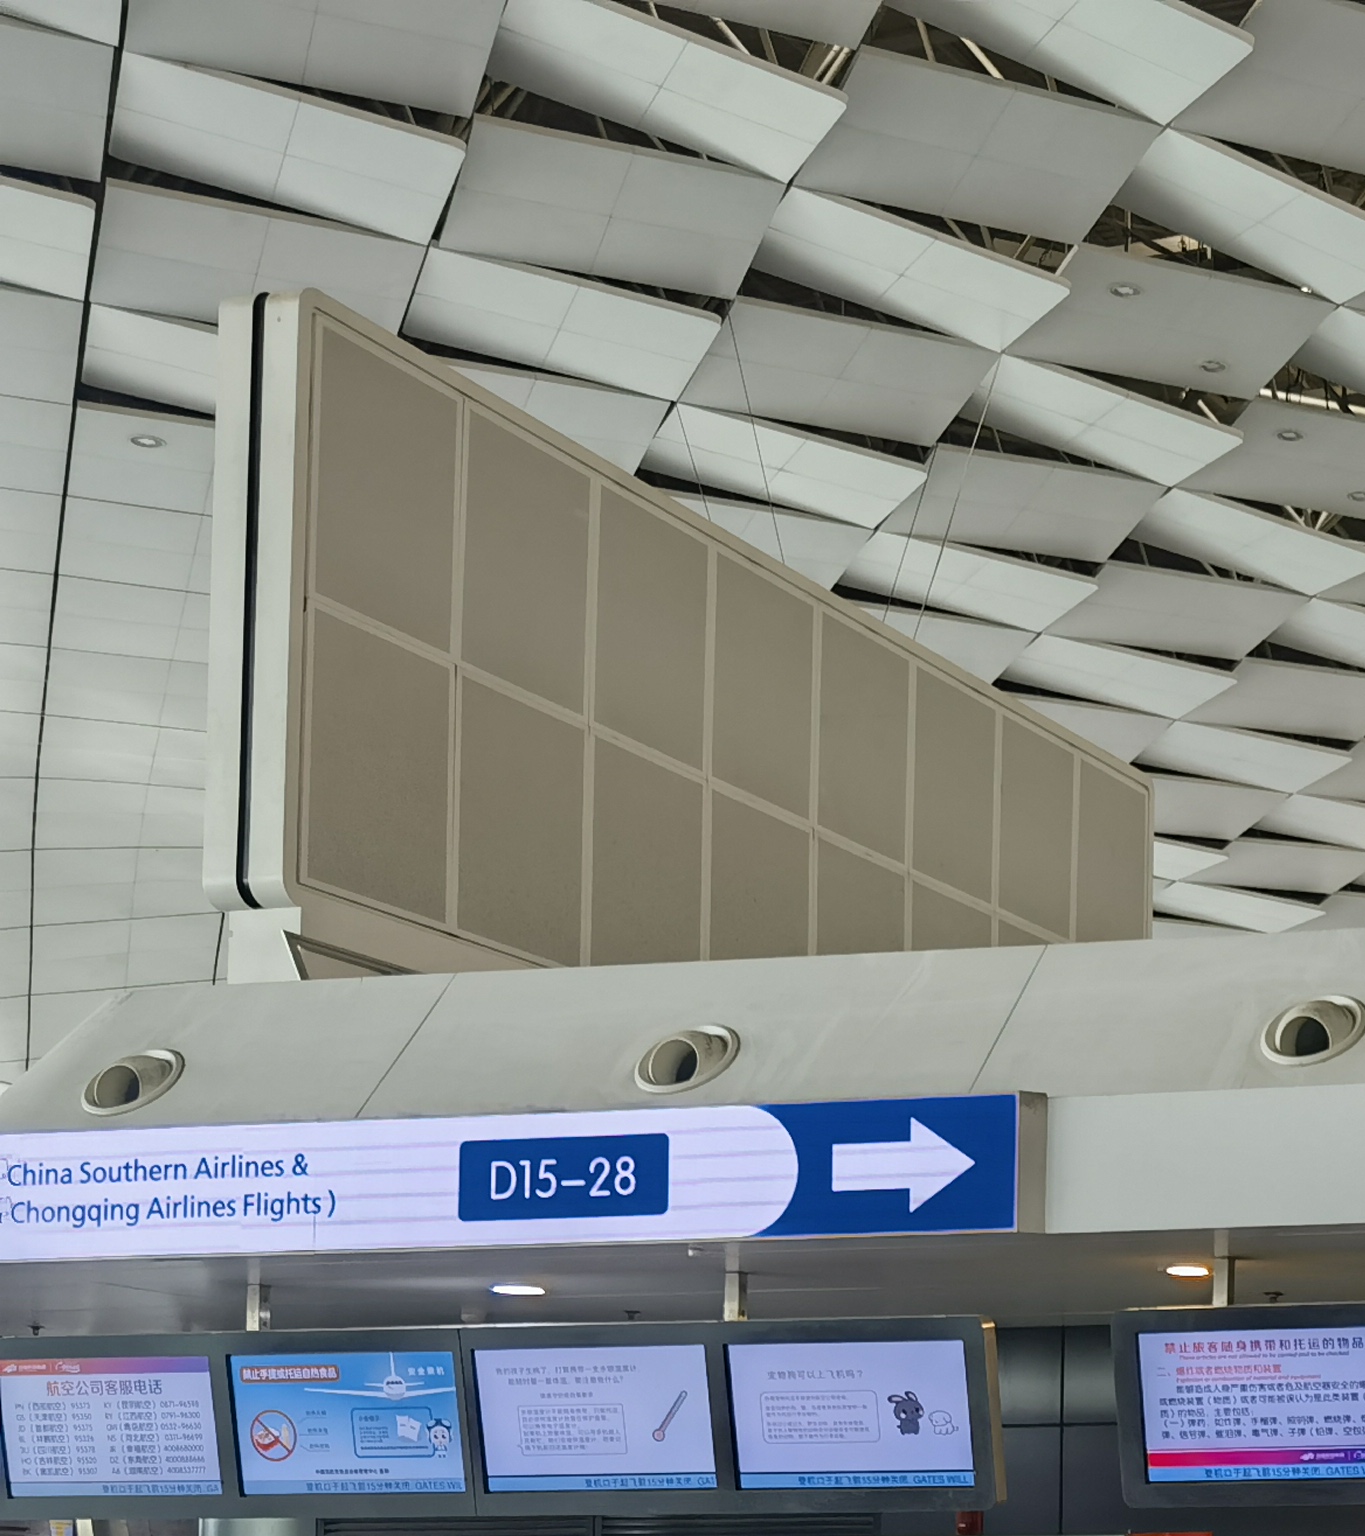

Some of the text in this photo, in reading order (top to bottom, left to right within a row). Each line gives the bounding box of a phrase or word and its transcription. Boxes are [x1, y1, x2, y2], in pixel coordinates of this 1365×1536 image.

[8, 1153, 309, 1187] China Southern Airlines &
[489, 1155, 637, 1202] D15-28
[11, 1198, 140, 1228] Chongqing
[146, 1195, 237, 1220] Airlines
[1164, 1337, 1364, 1354] 禁止旅客随身携带和托运的物品
[46, 1379, 162, 1396] 航空公司客服电话
